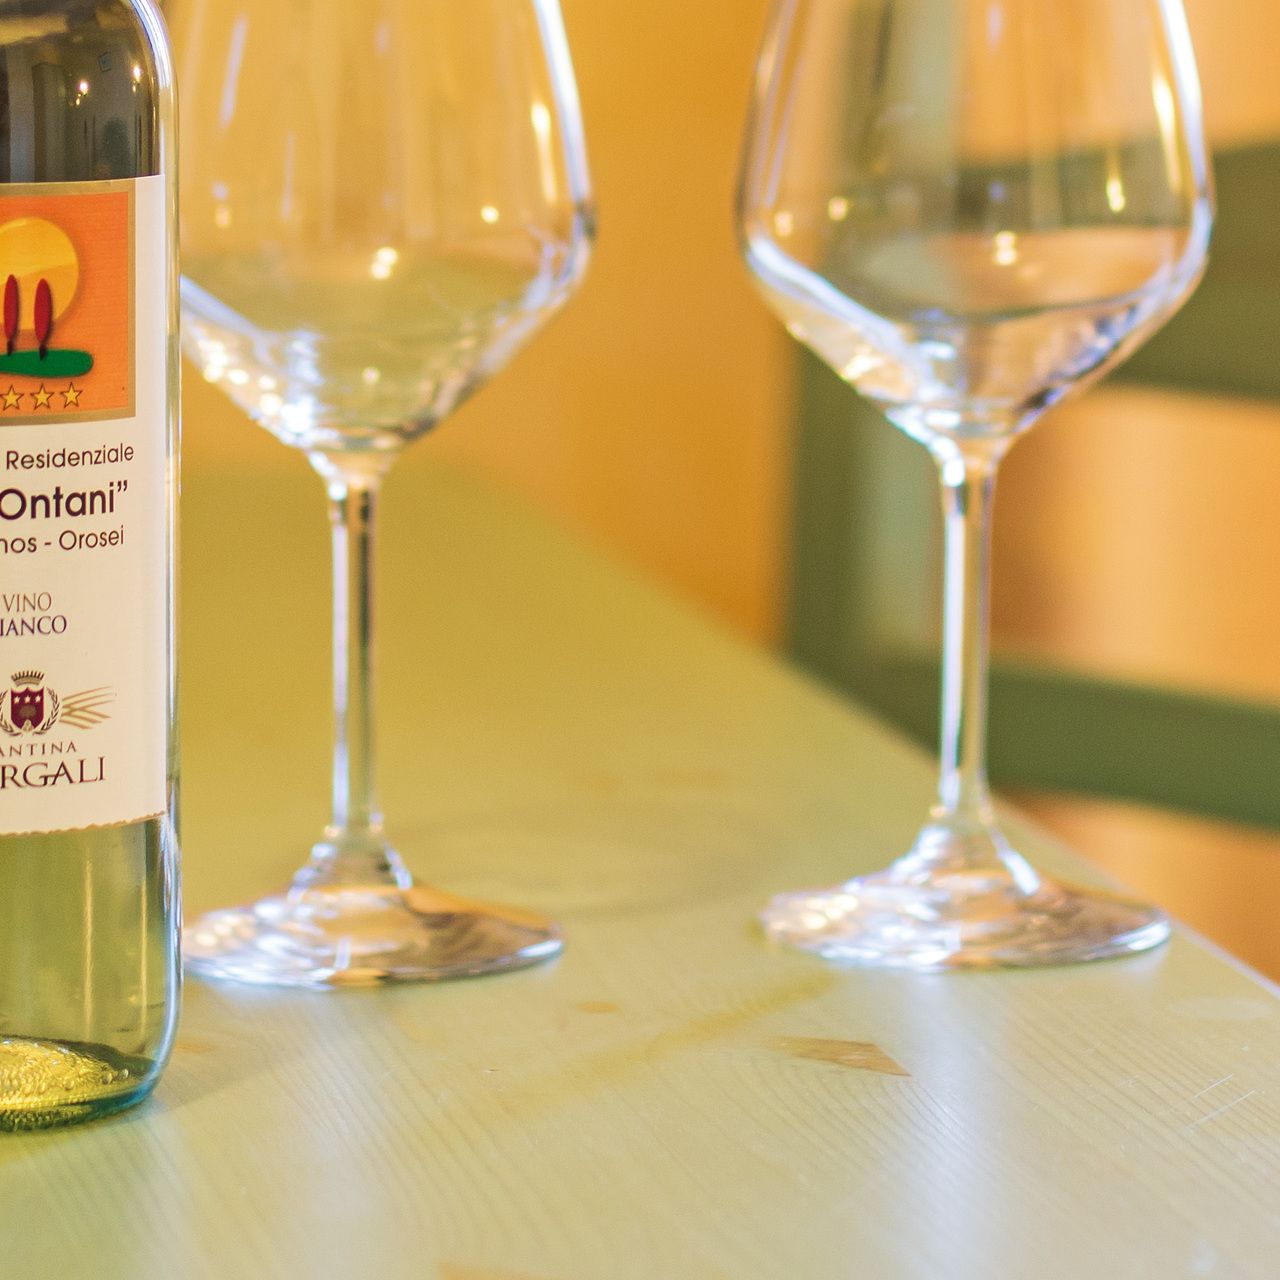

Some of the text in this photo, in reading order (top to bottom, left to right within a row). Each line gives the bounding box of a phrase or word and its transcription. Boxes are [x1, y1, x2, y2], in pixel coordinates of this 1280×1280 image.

[6, 443, 135, 470] Residenziale
[58, 525, 125, 550] Orosei
[2, 592, 52, 612] VINO
